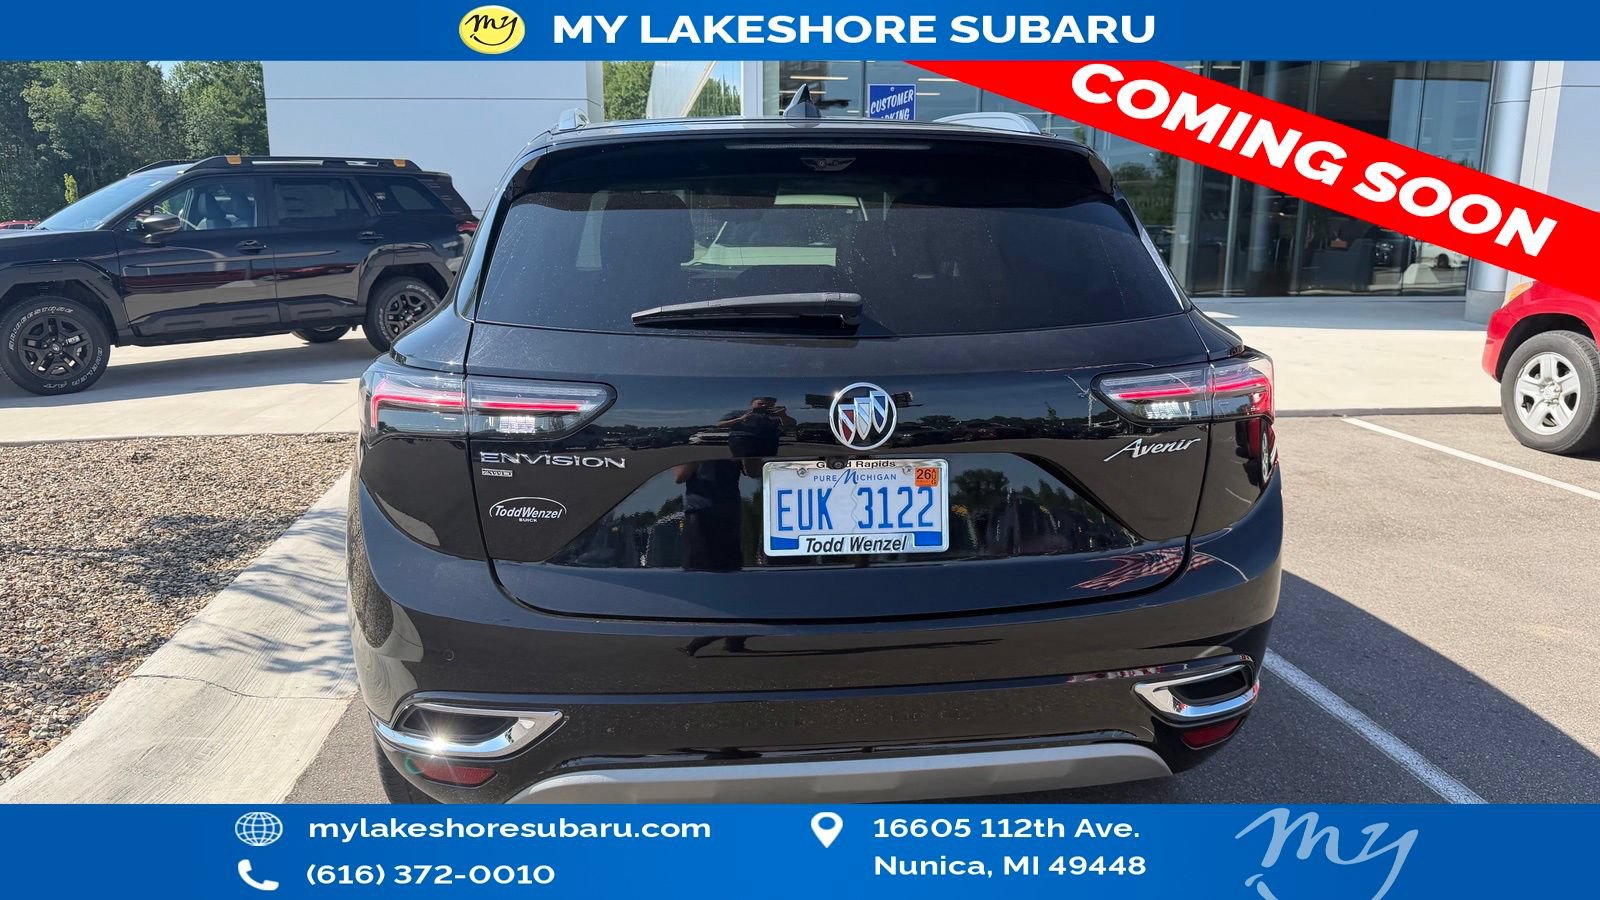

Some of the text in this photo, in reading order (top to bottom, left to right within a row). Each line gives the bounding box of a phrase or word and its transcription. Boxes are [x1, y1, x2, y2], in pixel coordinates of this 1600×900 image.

[870, 89, 914, 115] CUSTOMER
[1103, 438, 1201, 462] Avenir
[480, 452, 626, 469] ENVISION
[856, 460, 896, 469] Rapids
[916, 468, 931, 480] 26
[777, 486, 933, 532] EUK 3122
[806, 535, 907, 553] Todd Wenzel
